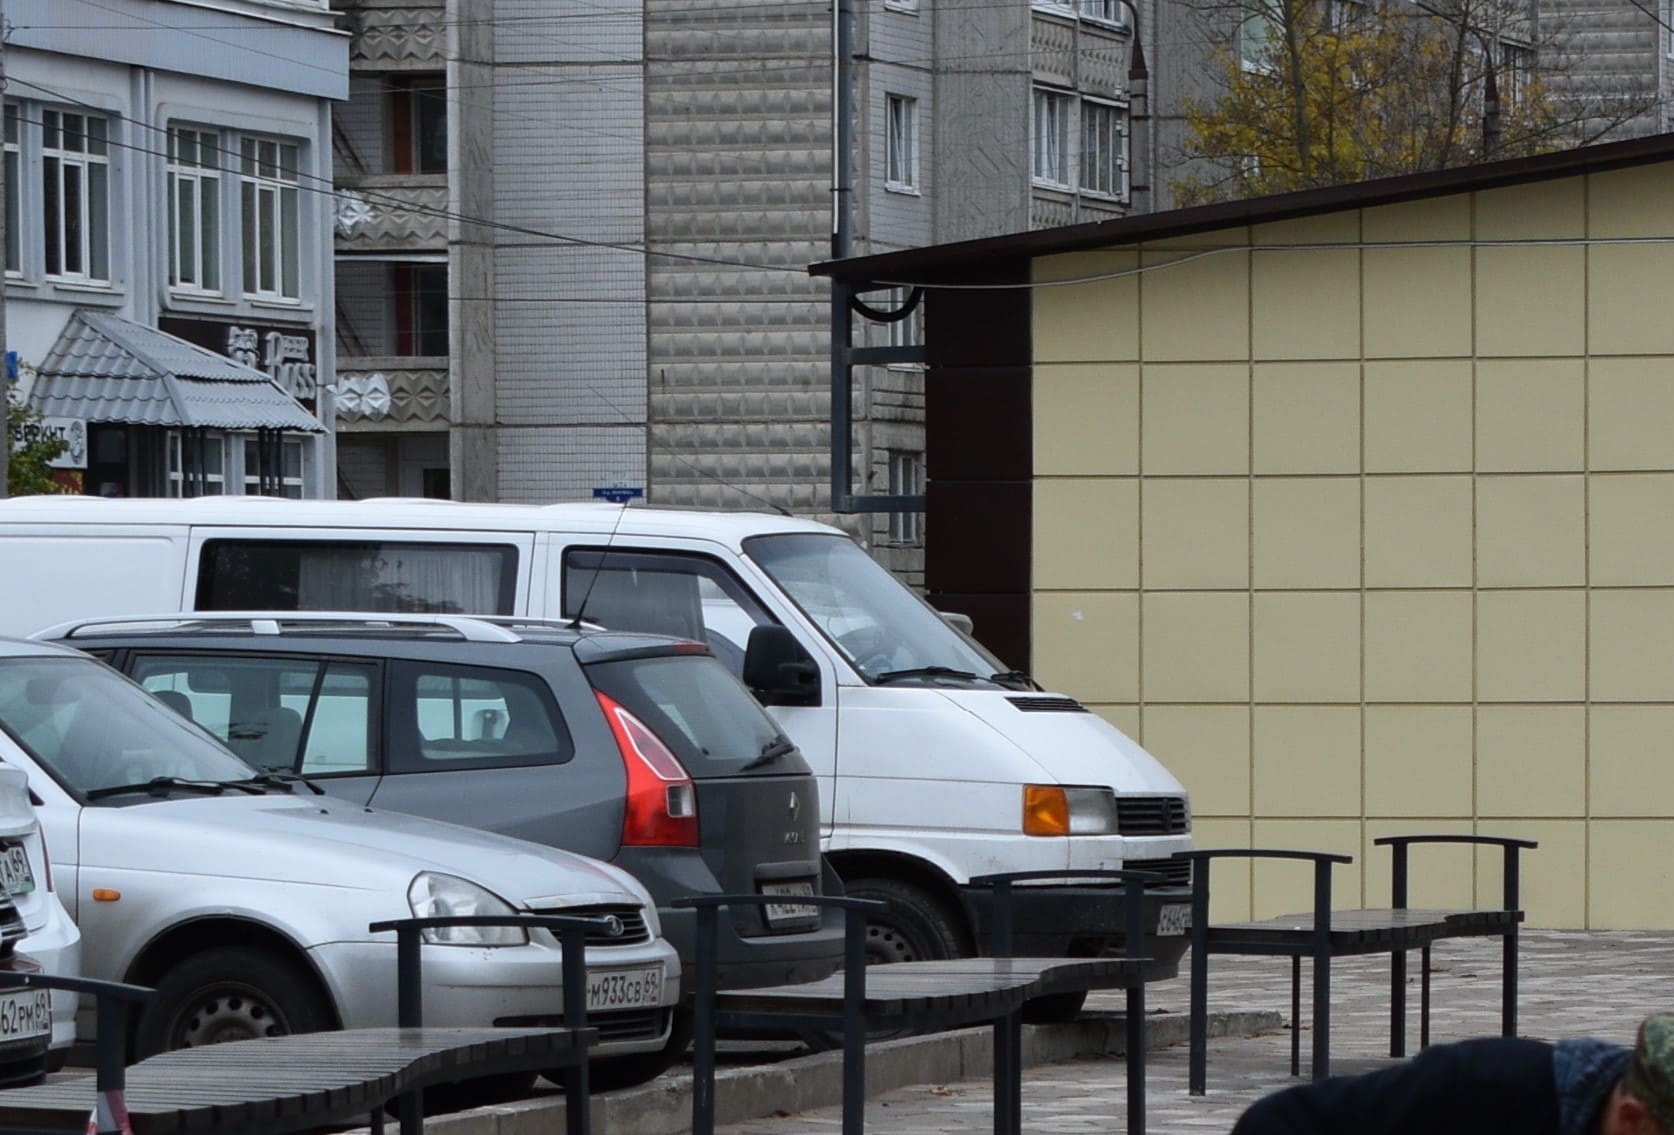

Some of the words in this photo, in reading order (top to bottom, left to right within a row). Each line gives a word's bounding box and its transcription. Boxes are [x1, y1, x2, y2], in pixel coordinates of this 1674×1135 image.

[591, 975, 642, 1006] М933СВ
[644, 971, 658, 994] 69
[35, 992, 46, 1018] 69
